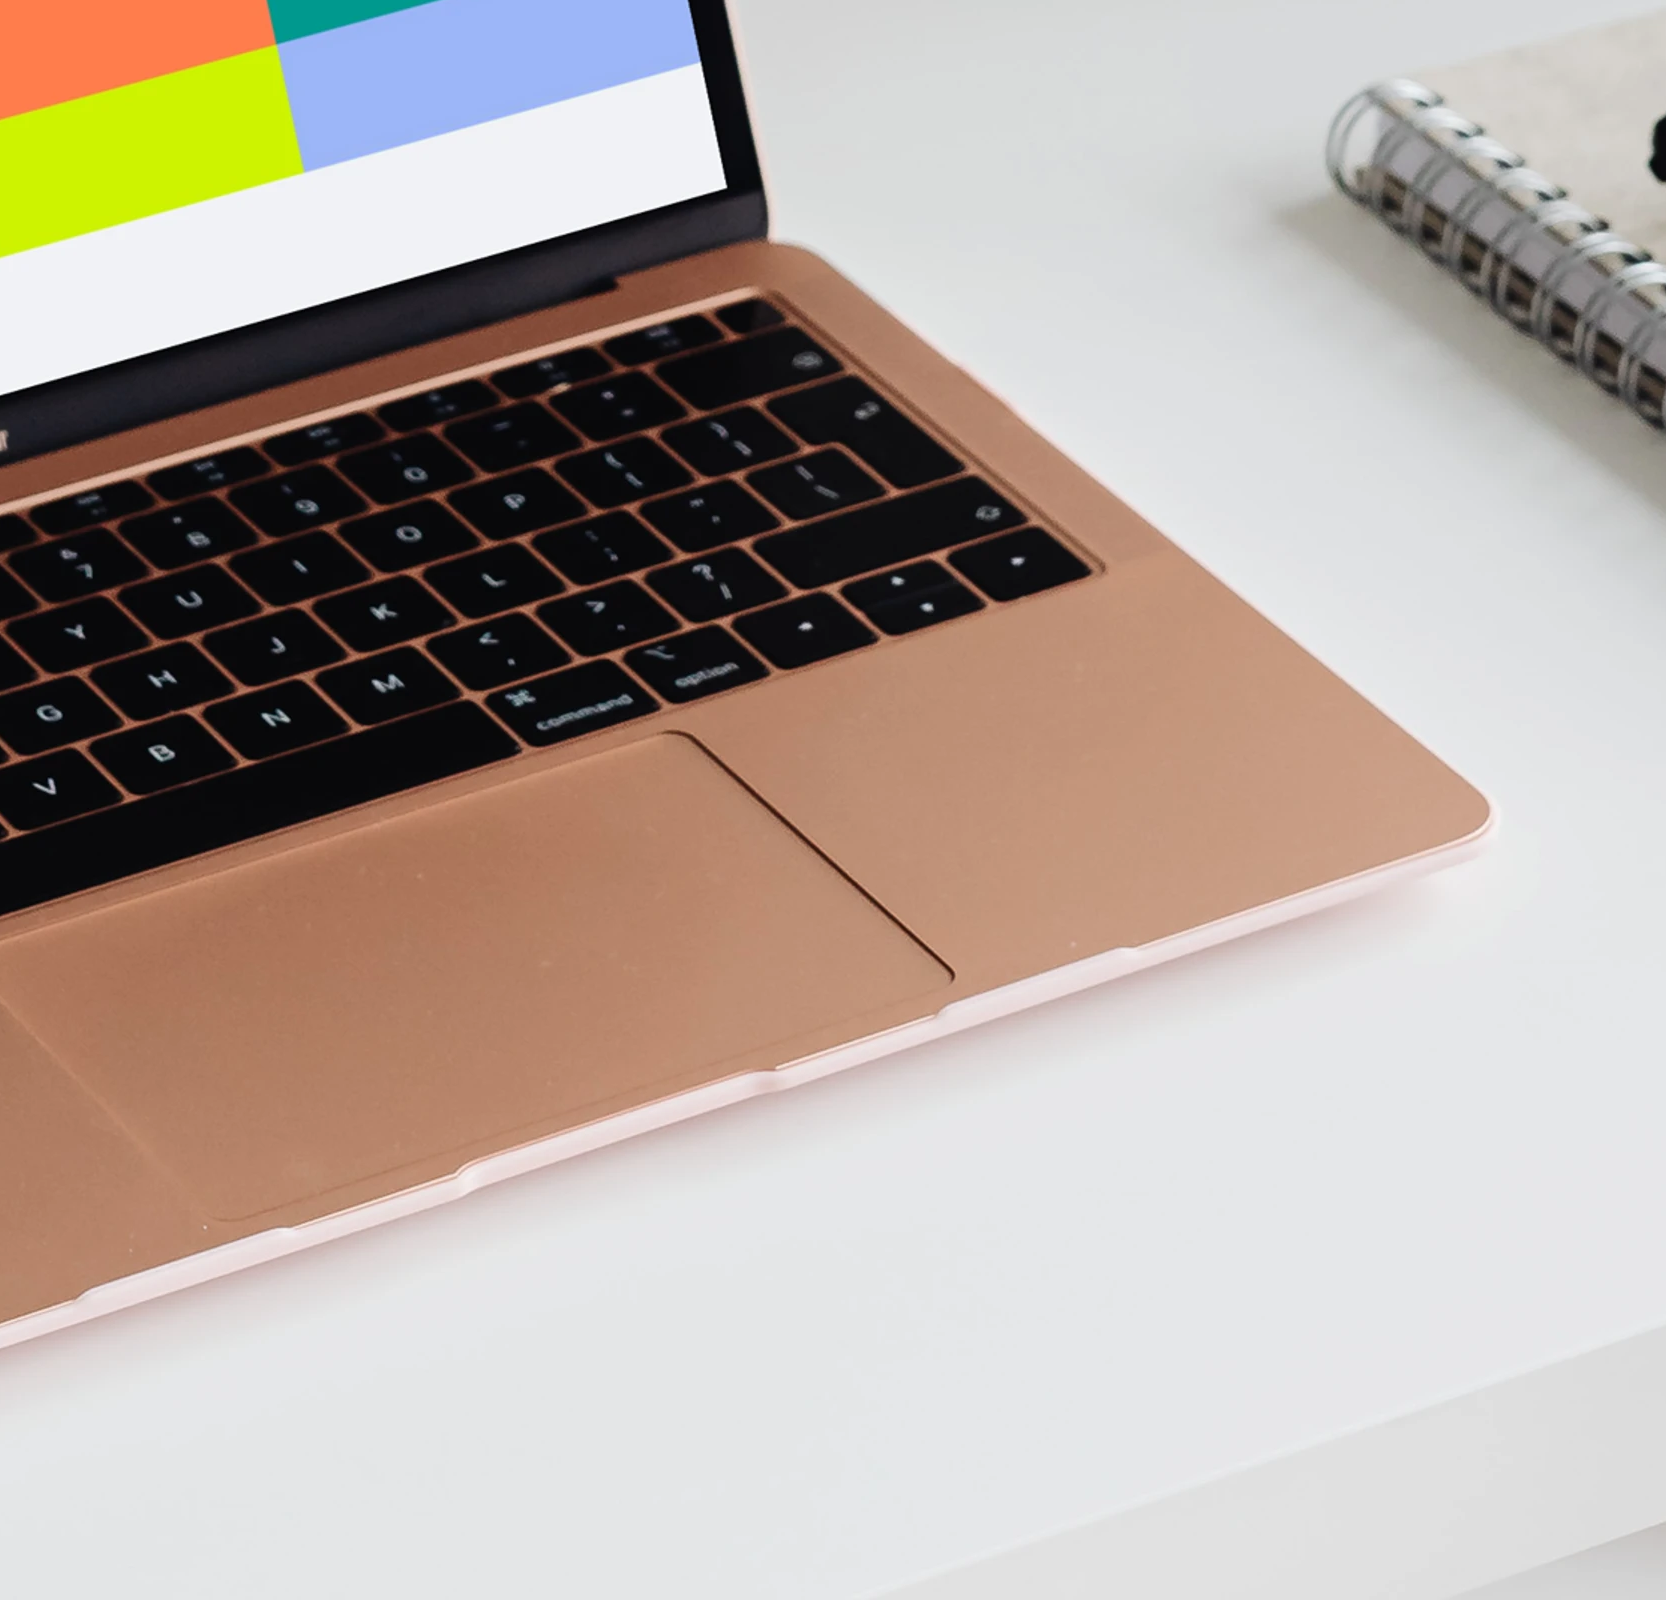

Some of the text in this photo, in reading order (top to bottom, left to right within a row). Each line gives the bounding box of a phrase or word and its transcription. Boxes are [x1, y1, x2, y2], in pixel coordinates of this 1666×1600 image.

[64, 624, 86, 640] Y
[175, 591, 203, 608] U
[396, 526, 423, 542] O
[36, 704, 63, 722] G
[147, 669, 178, 688] H
[271, 636, 286, 654] J
[370, 603, 398, 621] K
[481, 573, 506, 588] L
[536, 693, 634, 731] command
[674, 662, 740, 688] option
[32, 777, 57, 796] V
[147, 744, 176, 763] B
[260, 708, 292, 728] N
[371, 673, 405, 694] M
